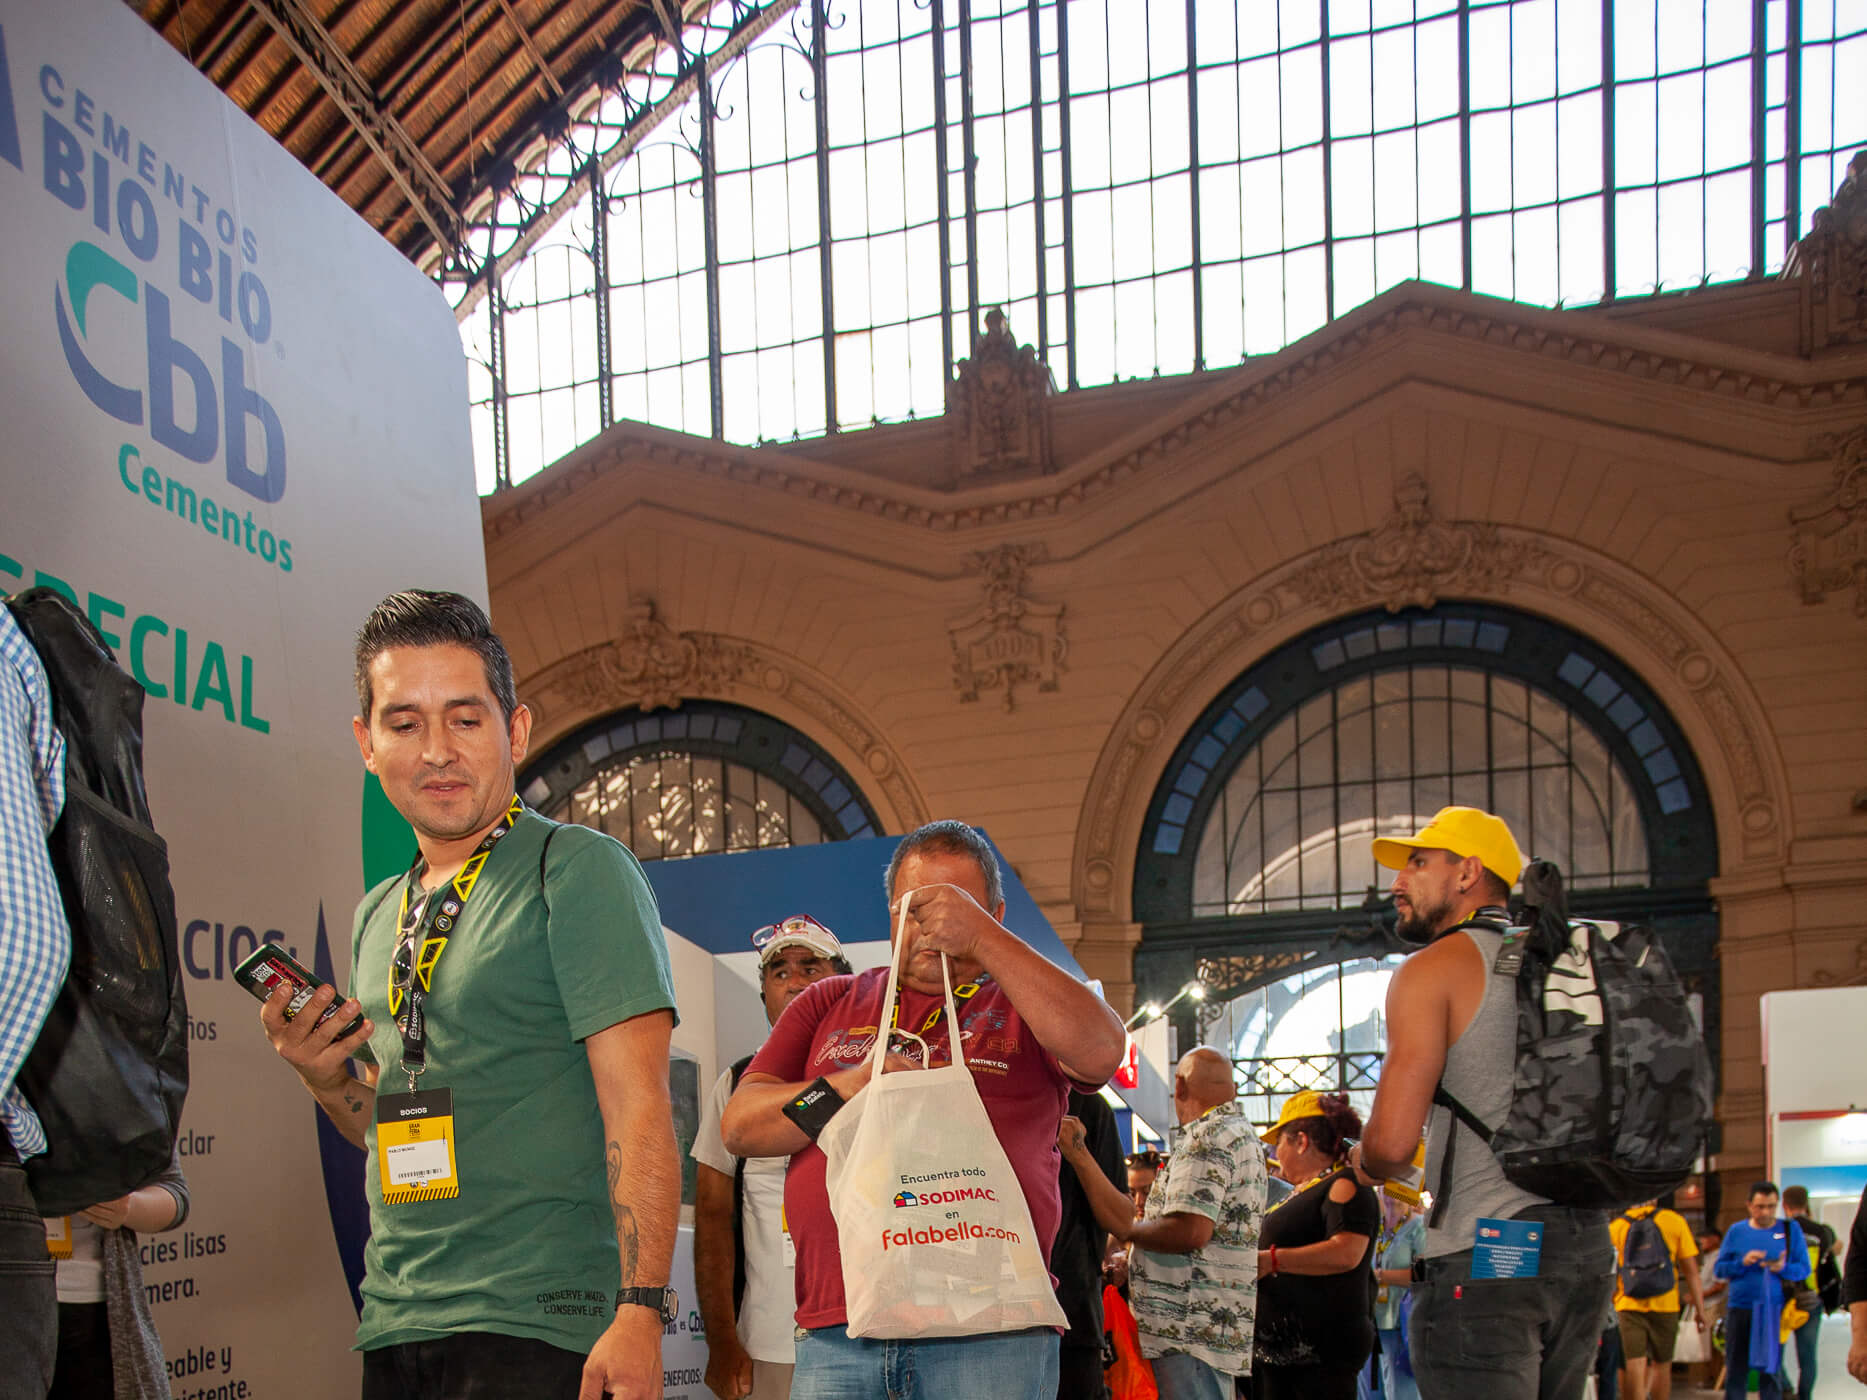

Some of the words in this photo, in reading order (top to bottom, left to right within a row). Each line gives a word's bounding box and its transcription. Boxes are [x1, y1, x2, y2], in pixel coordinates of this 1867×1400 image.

[39, 63, 258, 265] CEMENTOS
[42, 109, 160, 263] BIO
[178, 216, 272, 344] BIO
[54, 240, 288, 504] Cbb
[118, 443, 293, 573] Cementos
[400, 1107, 428, 1117] SOCIOS
[900, 1169, 960, 1185] Encuentra
[962, 1166, 987, 1177] todo
[919, 1187, 996, 1206] SODIMAC
[945, 1210, 960, 1220] en
[184, 1232, 227, 1259] lisas
[881, 1221, 1021, 1251] falabella.com
[220, 1346, 232, 1373] y
